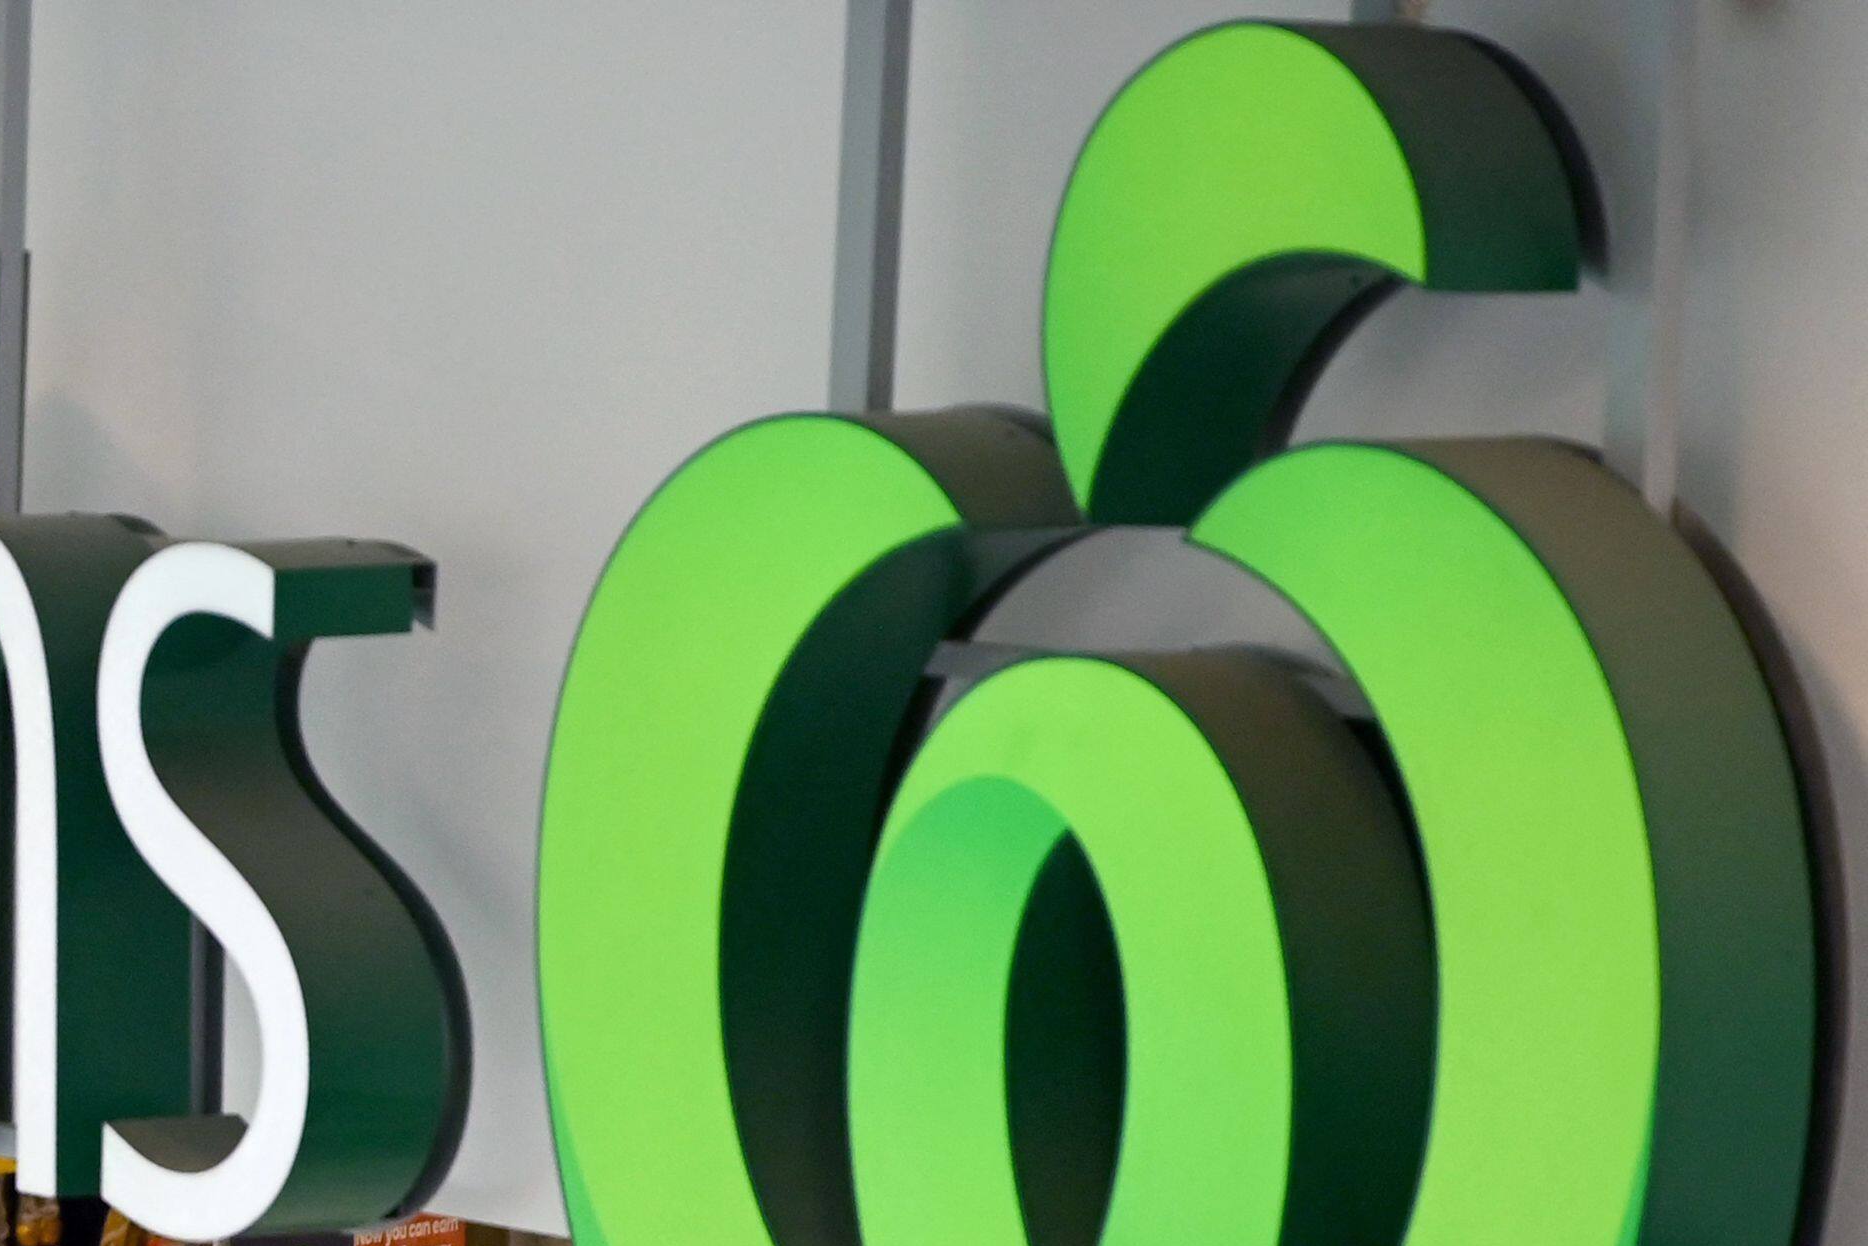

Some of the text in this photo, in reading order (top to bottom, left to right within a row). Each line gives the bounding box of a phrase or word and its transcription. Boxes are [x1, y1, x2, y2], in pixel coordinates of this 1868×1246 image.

[385, 1225, 407, 1246] you
[409, 1221, 431, 1237] can
[432, 1216, 459, 1234] earn
